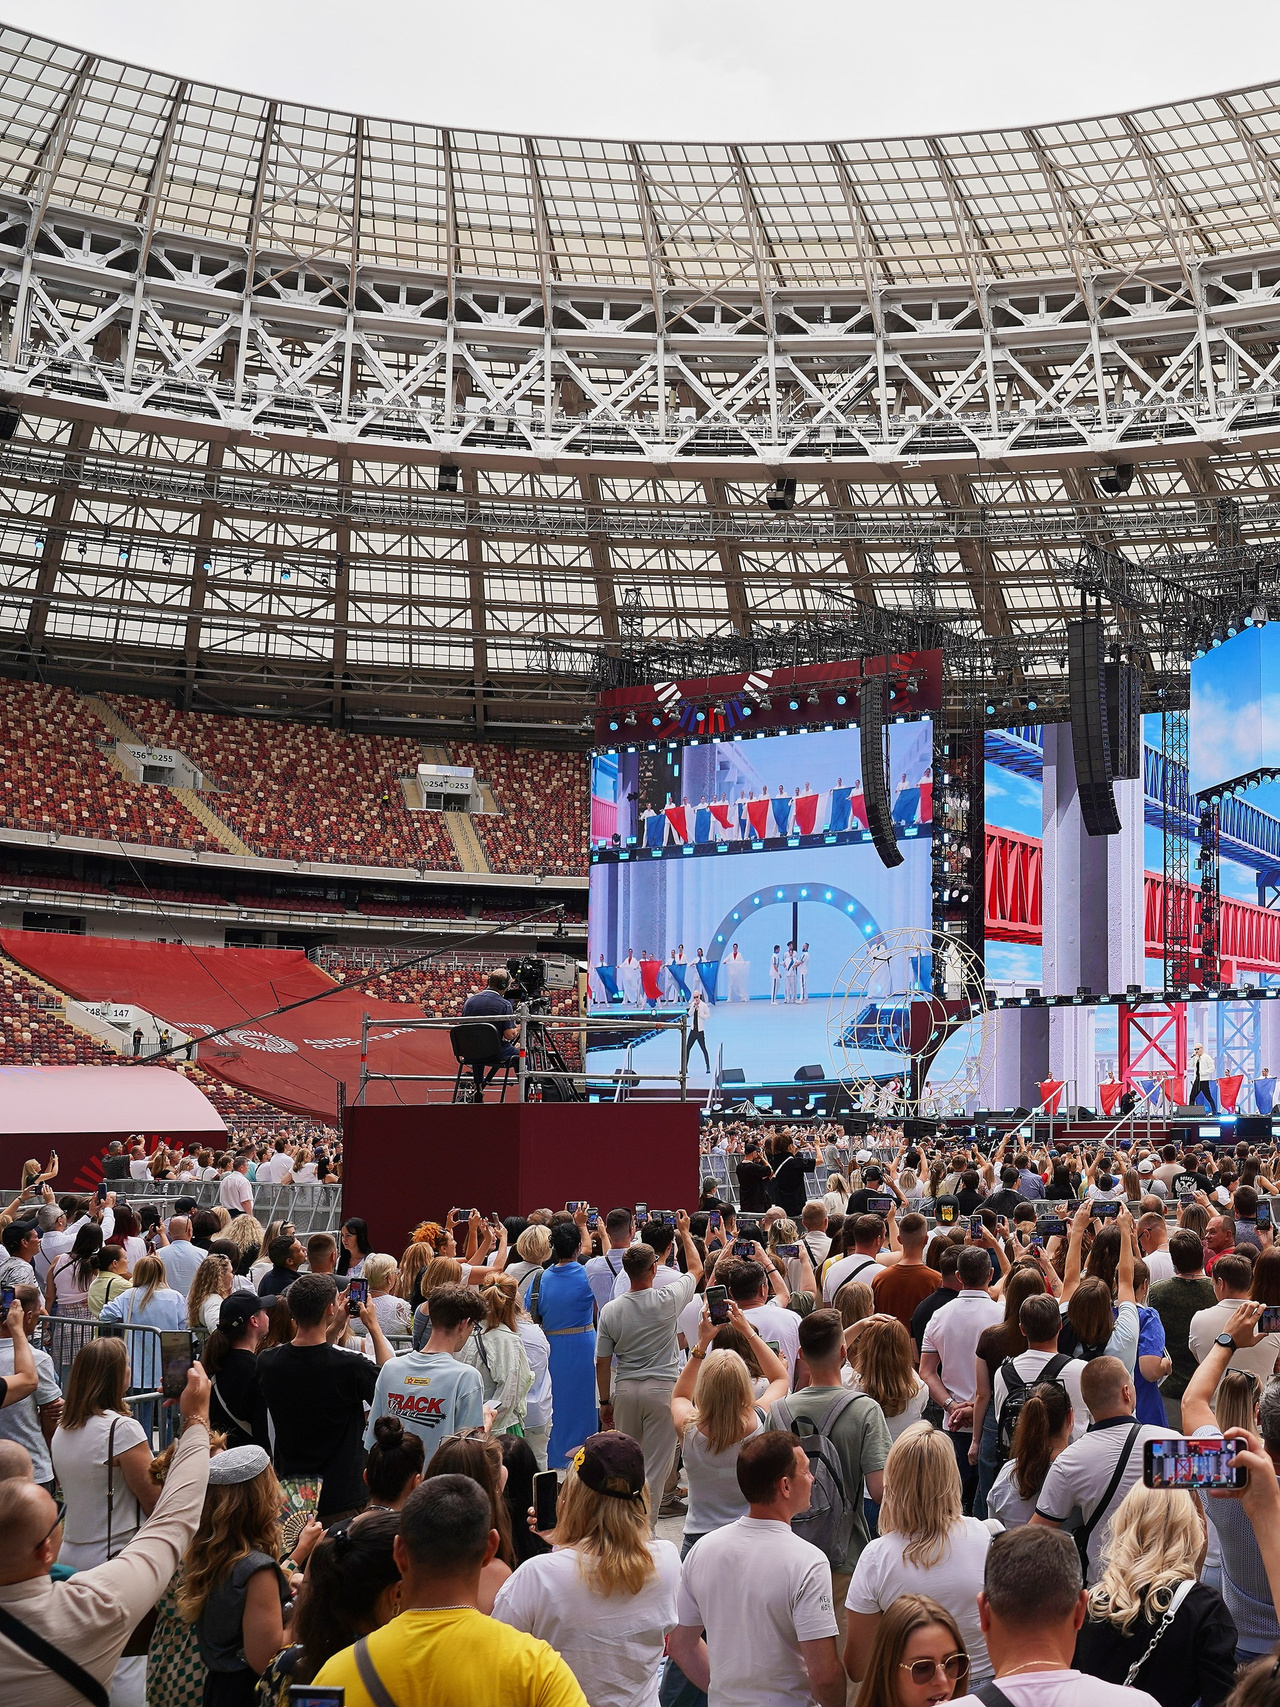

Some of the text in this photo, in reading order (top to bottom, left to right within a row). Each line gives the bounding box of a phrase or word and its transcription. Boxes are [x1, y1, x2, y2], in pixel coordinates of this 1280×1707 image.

[131, 751, 173, 762] 256 255
[114, 1009, 129, 1017] 147
[387, 1392, 446, 1414] TRACK
